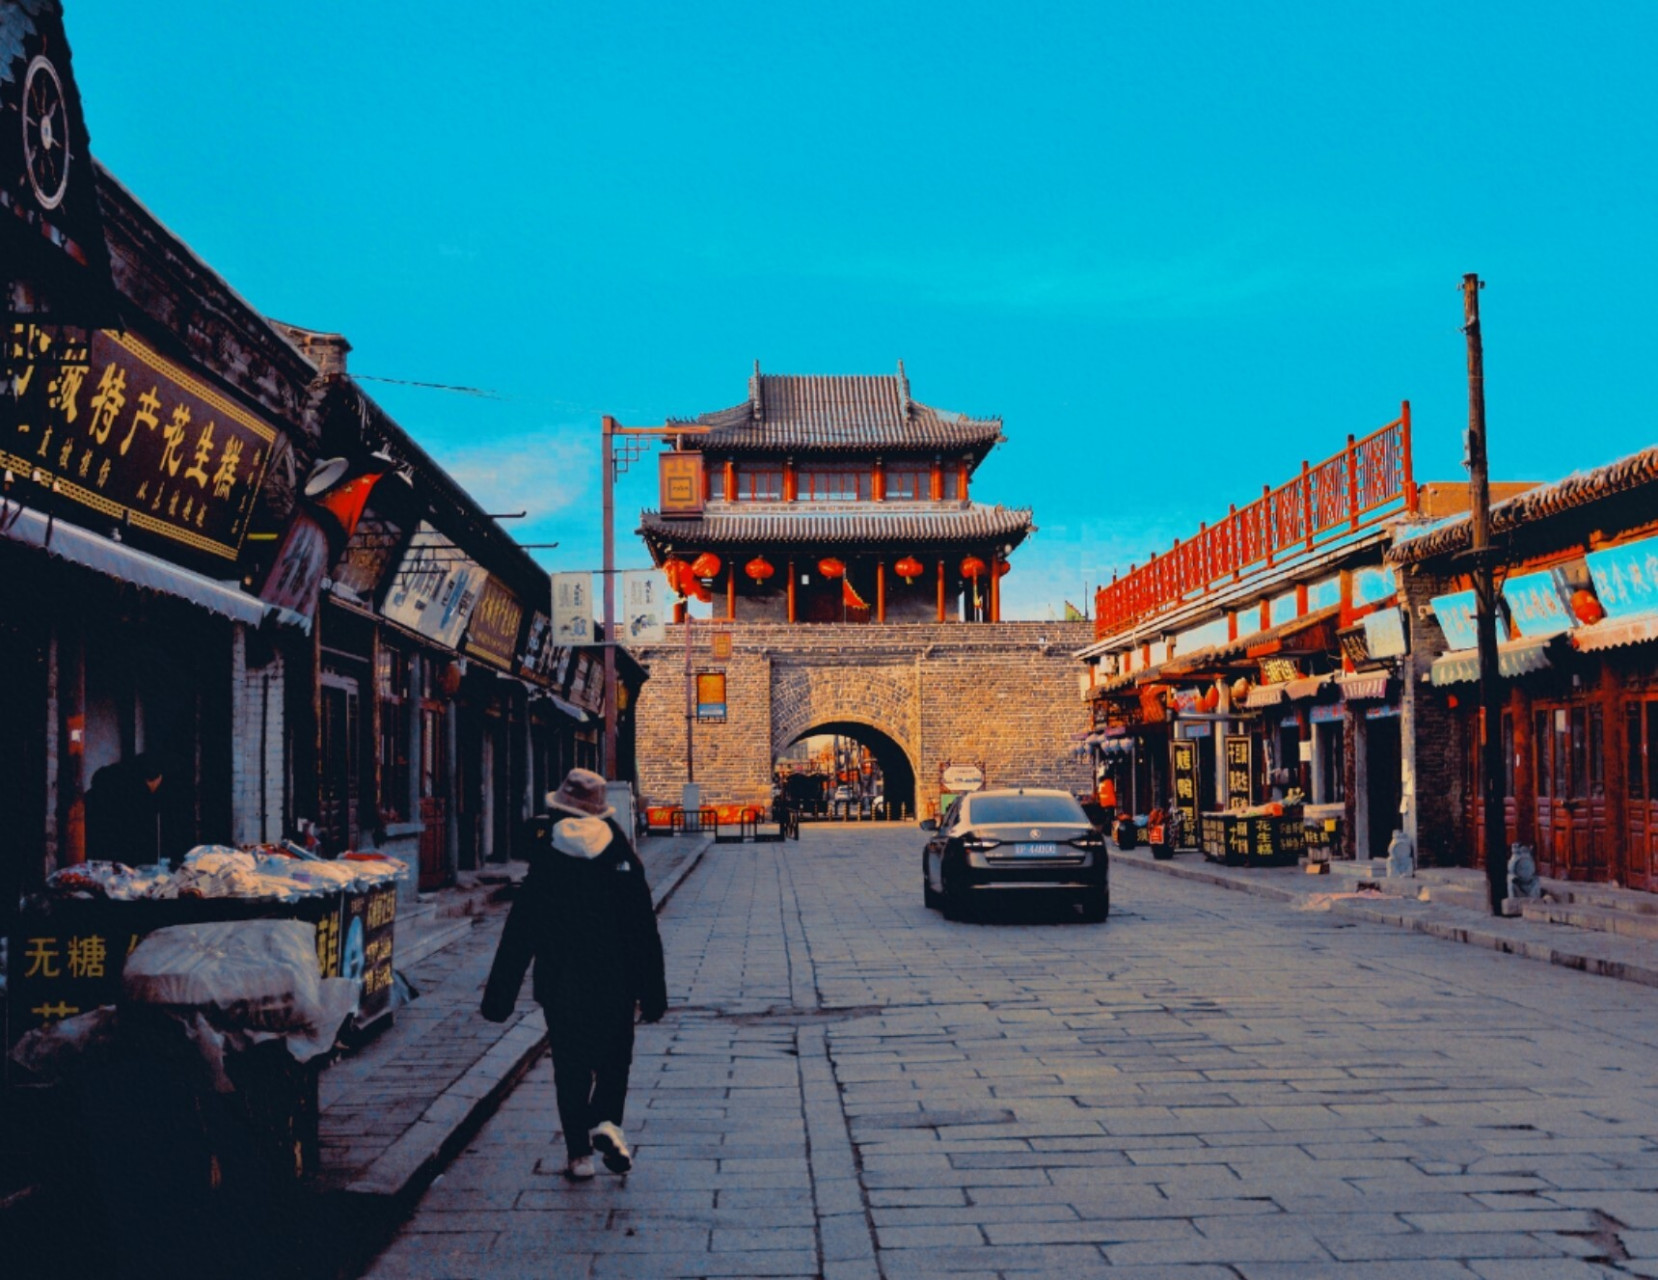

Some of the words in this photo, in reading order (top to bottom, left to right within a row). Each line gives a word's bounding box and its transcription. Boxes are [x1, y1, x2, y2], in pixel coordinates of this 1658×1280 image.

[1256, 820, 1273, 855] 花生糕
[24, 933, 108, 978] 无糖
